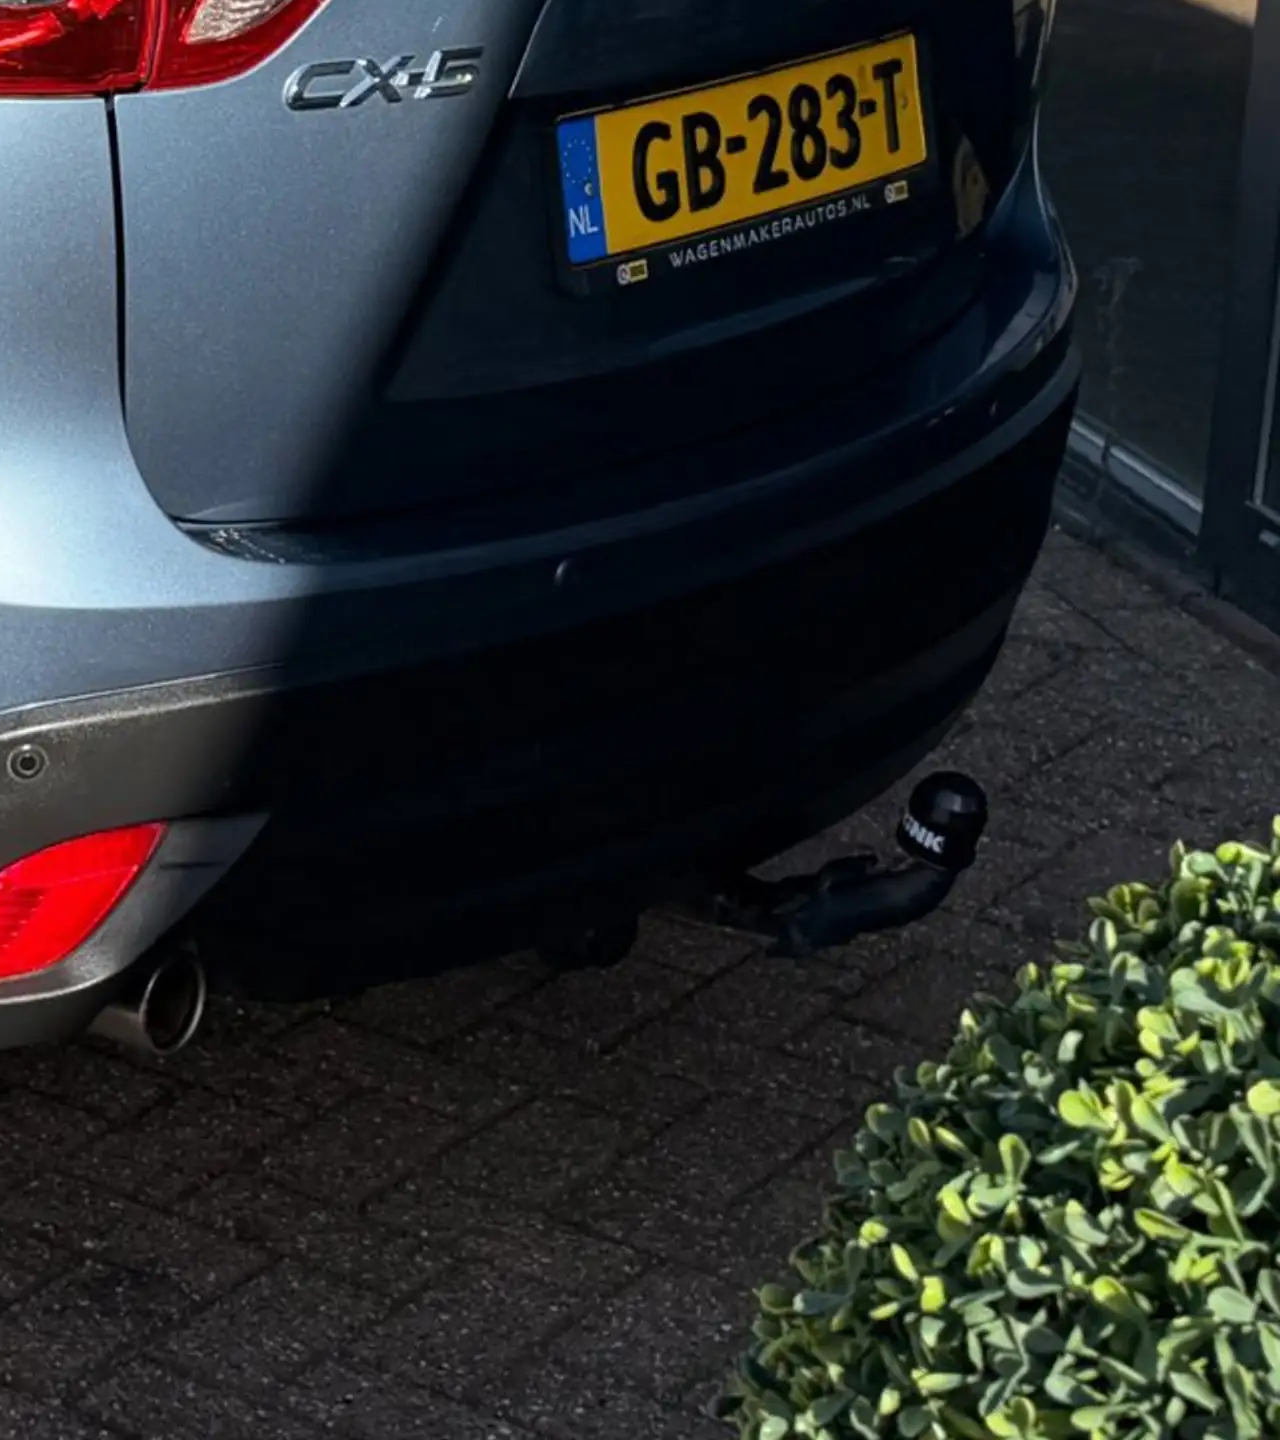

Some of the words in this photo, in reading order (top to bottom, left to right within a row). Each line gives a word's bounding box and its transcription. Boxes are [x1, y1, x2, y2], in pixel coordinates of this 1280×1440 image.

[281, 45, 486, 112] CX-5
[631, 58, 903, 224] GB-283-T
[568, 203, 600, 240] NL
